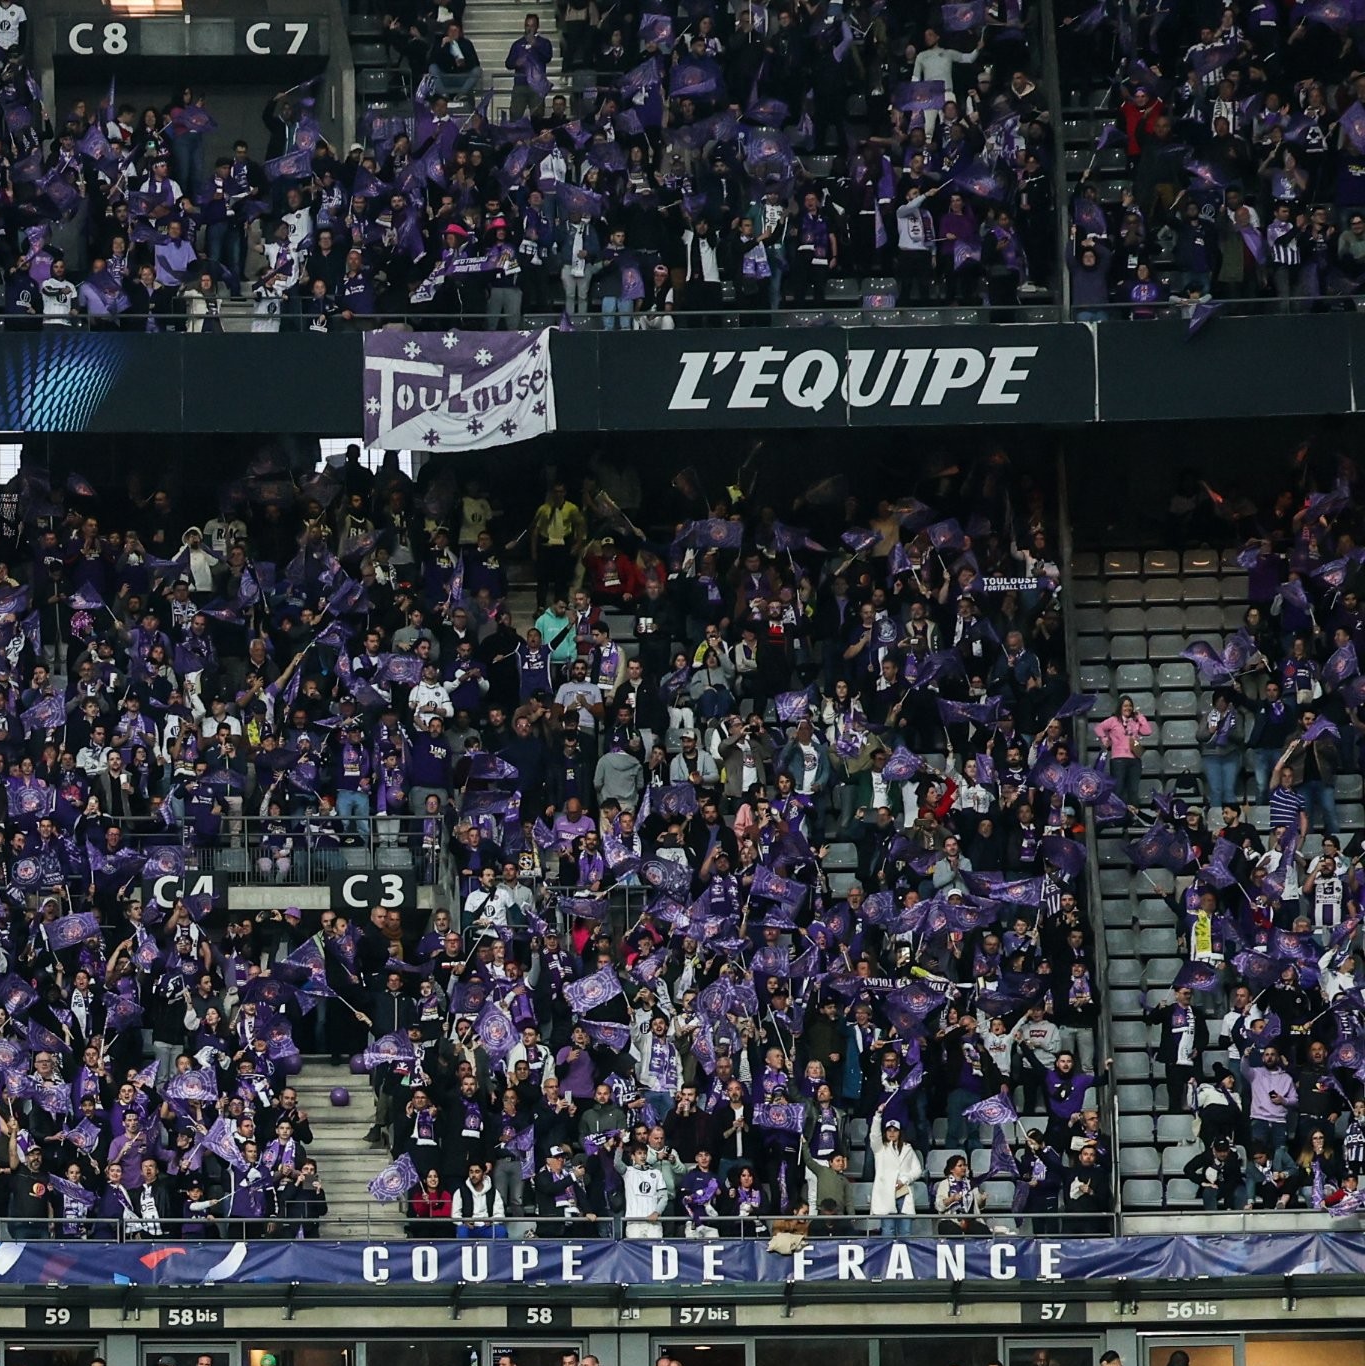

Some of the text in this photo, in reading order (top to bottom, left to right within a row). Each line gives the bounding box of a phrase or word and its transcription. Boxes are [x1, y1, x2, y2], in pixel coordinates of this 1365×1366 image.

[668, 345, 1040, 413] L'ÉQUIPE
[982, 577, 1039, 586] TOULOUSE
[983, 582, 1038, 592] FOOTBALL CLUB
[362, 1242, 1063, 1284] COUPE DE FRANCE
[44, 1307, 71, 1325] 59
[167, 1307, 218, 1326] 58 bis
[526, 1306, 553, 1325] 58
[679, 1304, 730, 1324] 57 bis
[1040, 1303, 1067, 1321] 57
[1166, 1301, 1218, 1319] 56 bis
